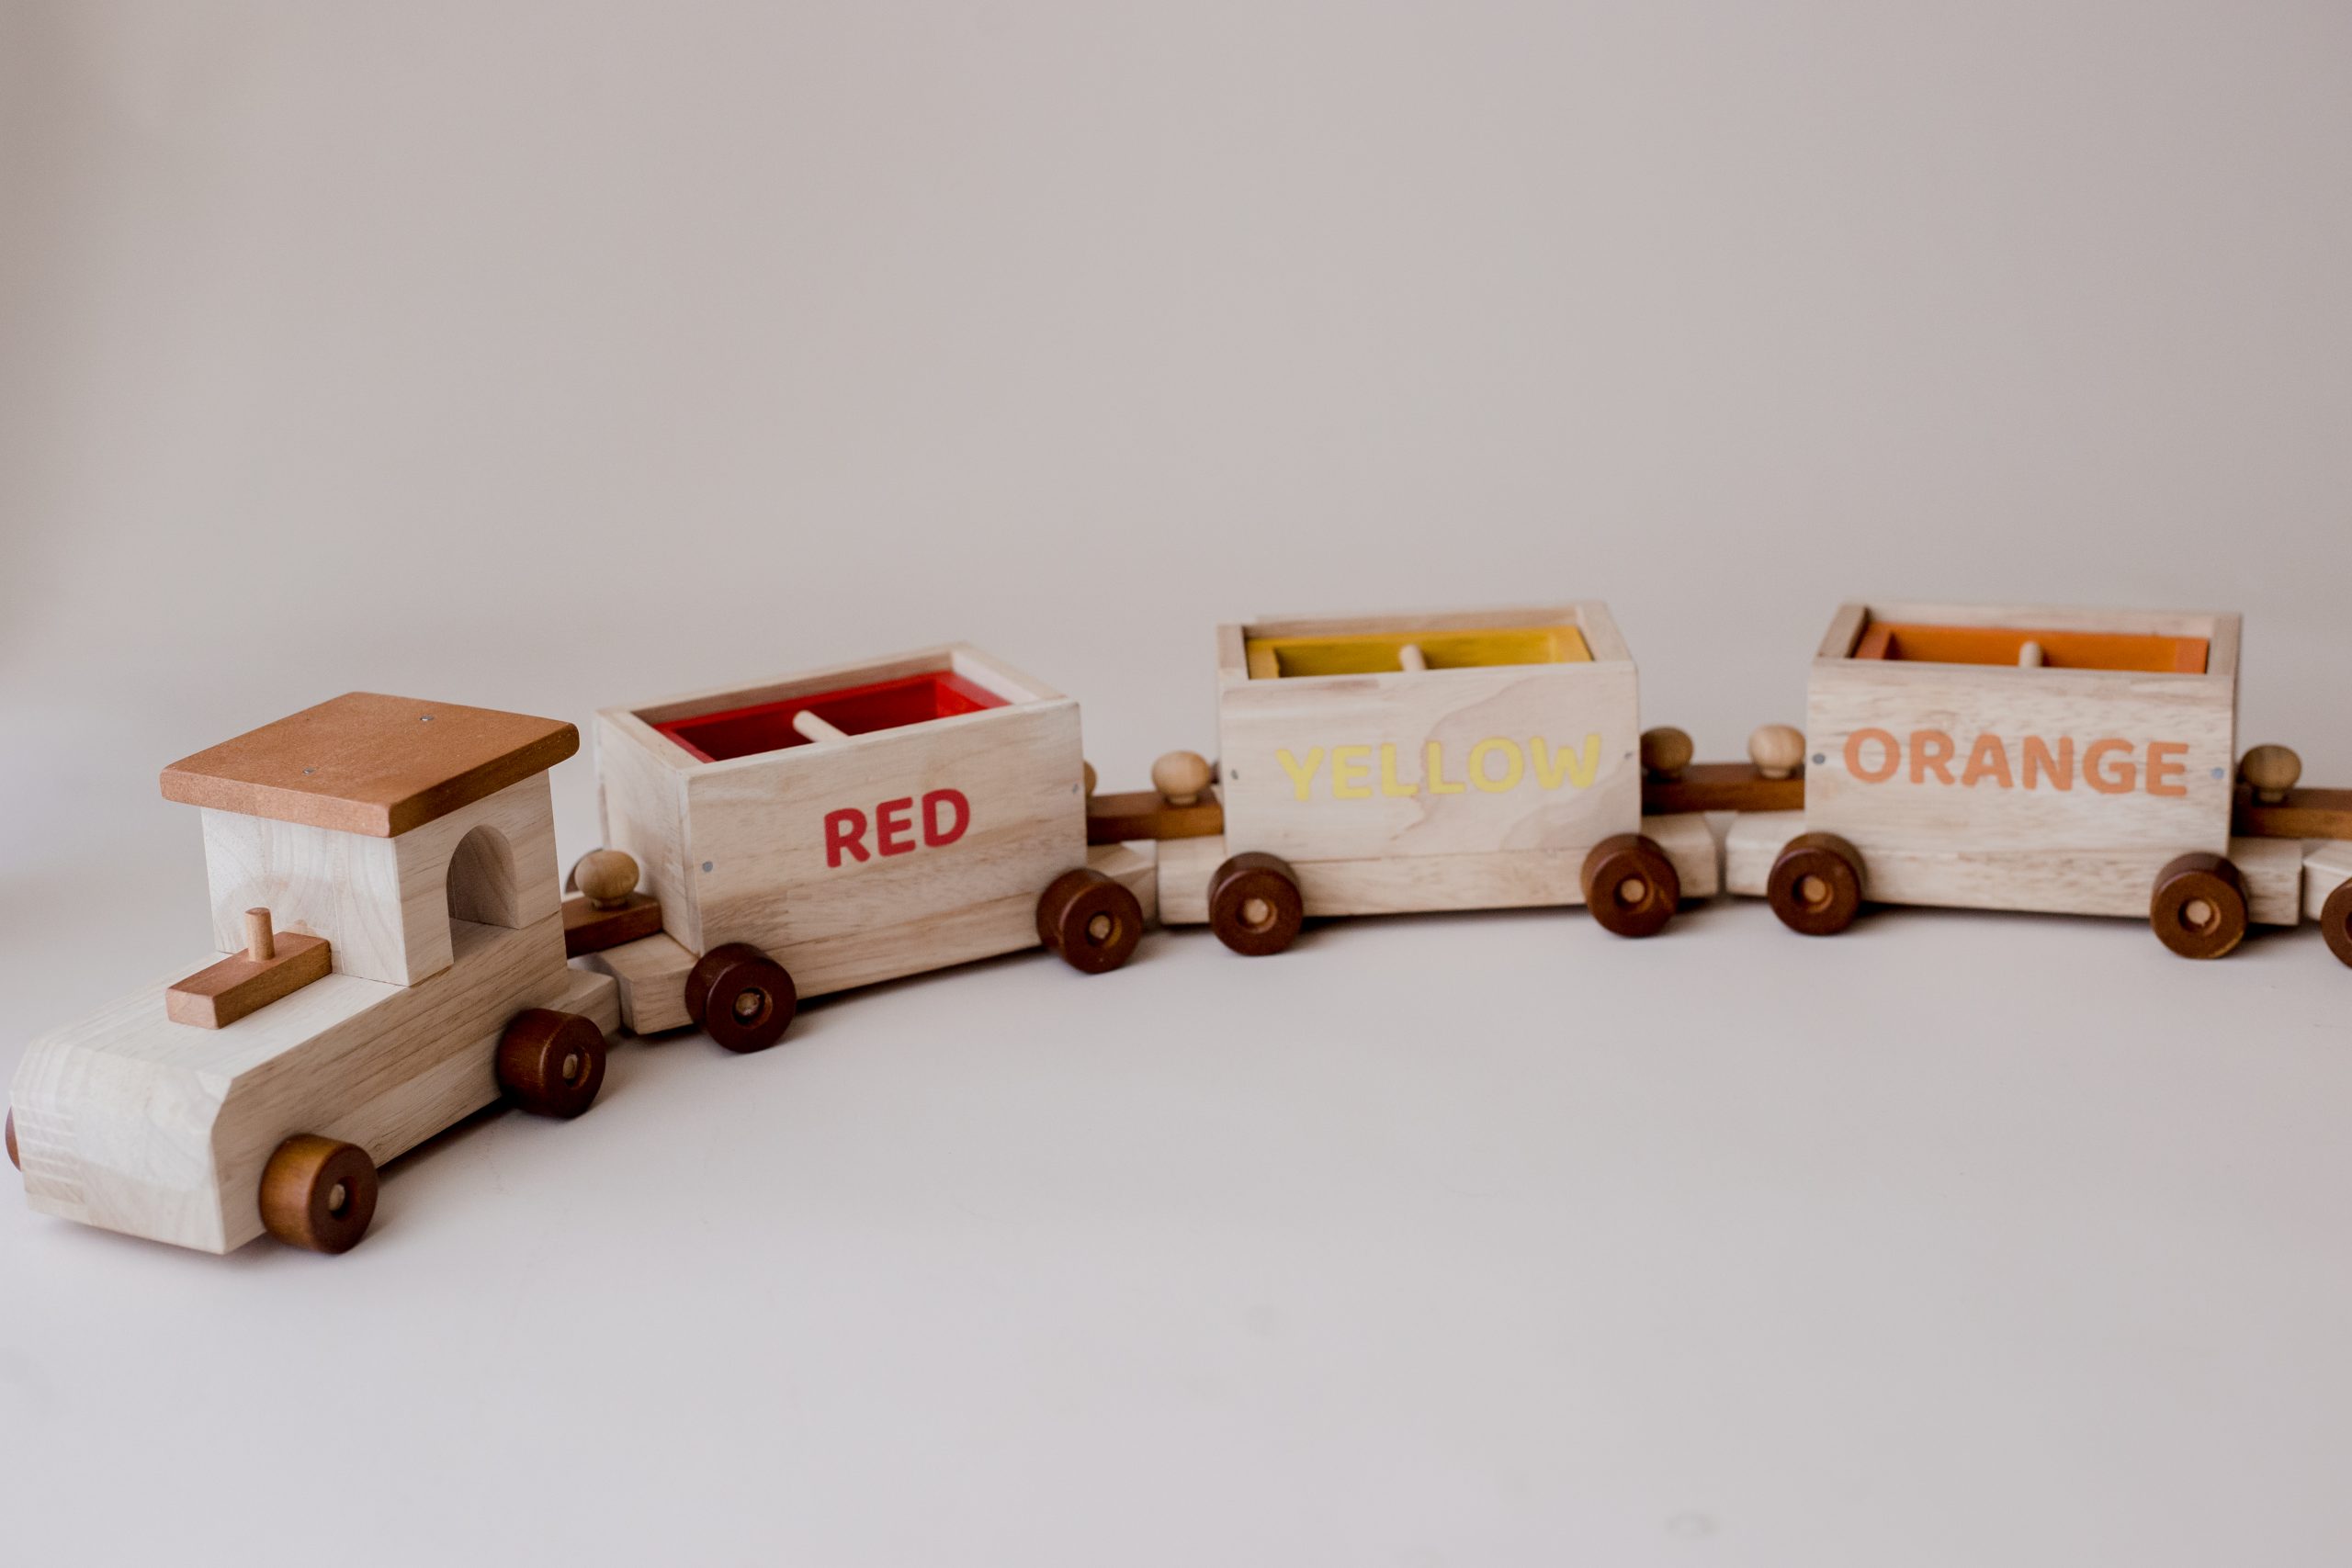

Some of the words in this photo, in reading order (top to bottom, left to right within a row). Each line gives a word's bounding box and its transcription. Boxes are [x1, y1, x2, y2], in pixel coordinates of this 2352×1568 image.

[1276, 734, 1600, 801] YELLOW
[1842, 727, 2190, 798] ORANGE
[824, 789, 971, 868] RED
